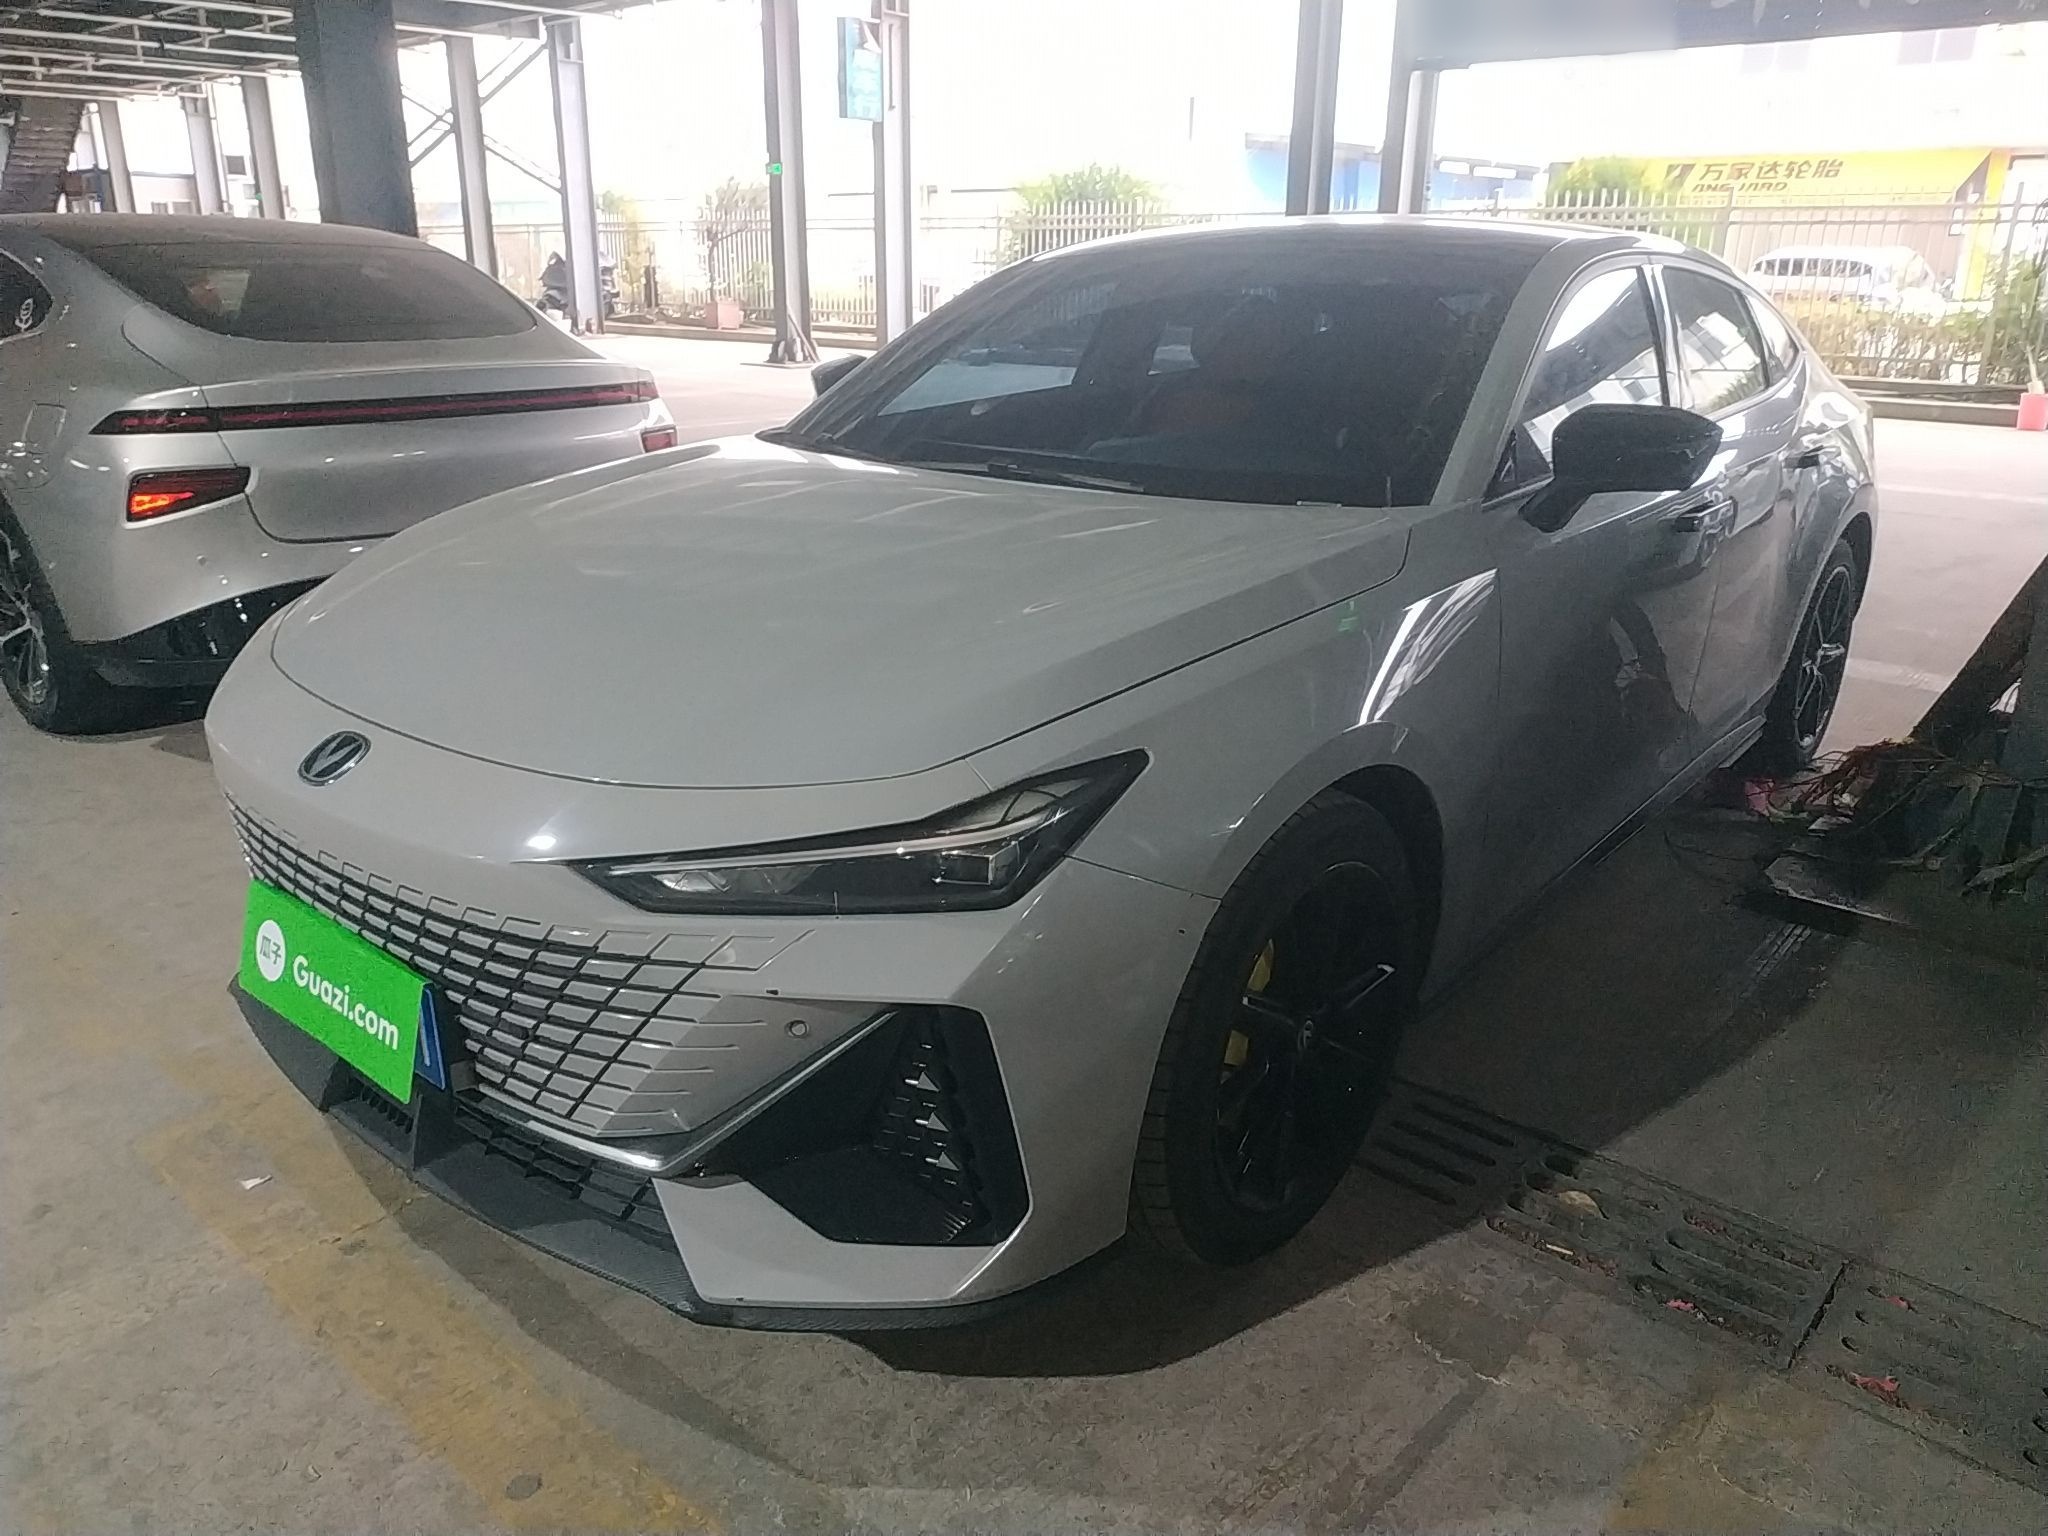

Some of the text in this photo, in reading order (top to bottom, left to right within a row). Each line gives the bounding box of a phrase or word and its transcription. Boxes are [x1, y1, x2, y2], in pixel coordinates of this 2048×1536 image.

[1699, 159, 1844, 181] 万家达轮胎
[260, 935, 282, 965] 瓜子
[293, 955, 399, 1050] Guazi.com
